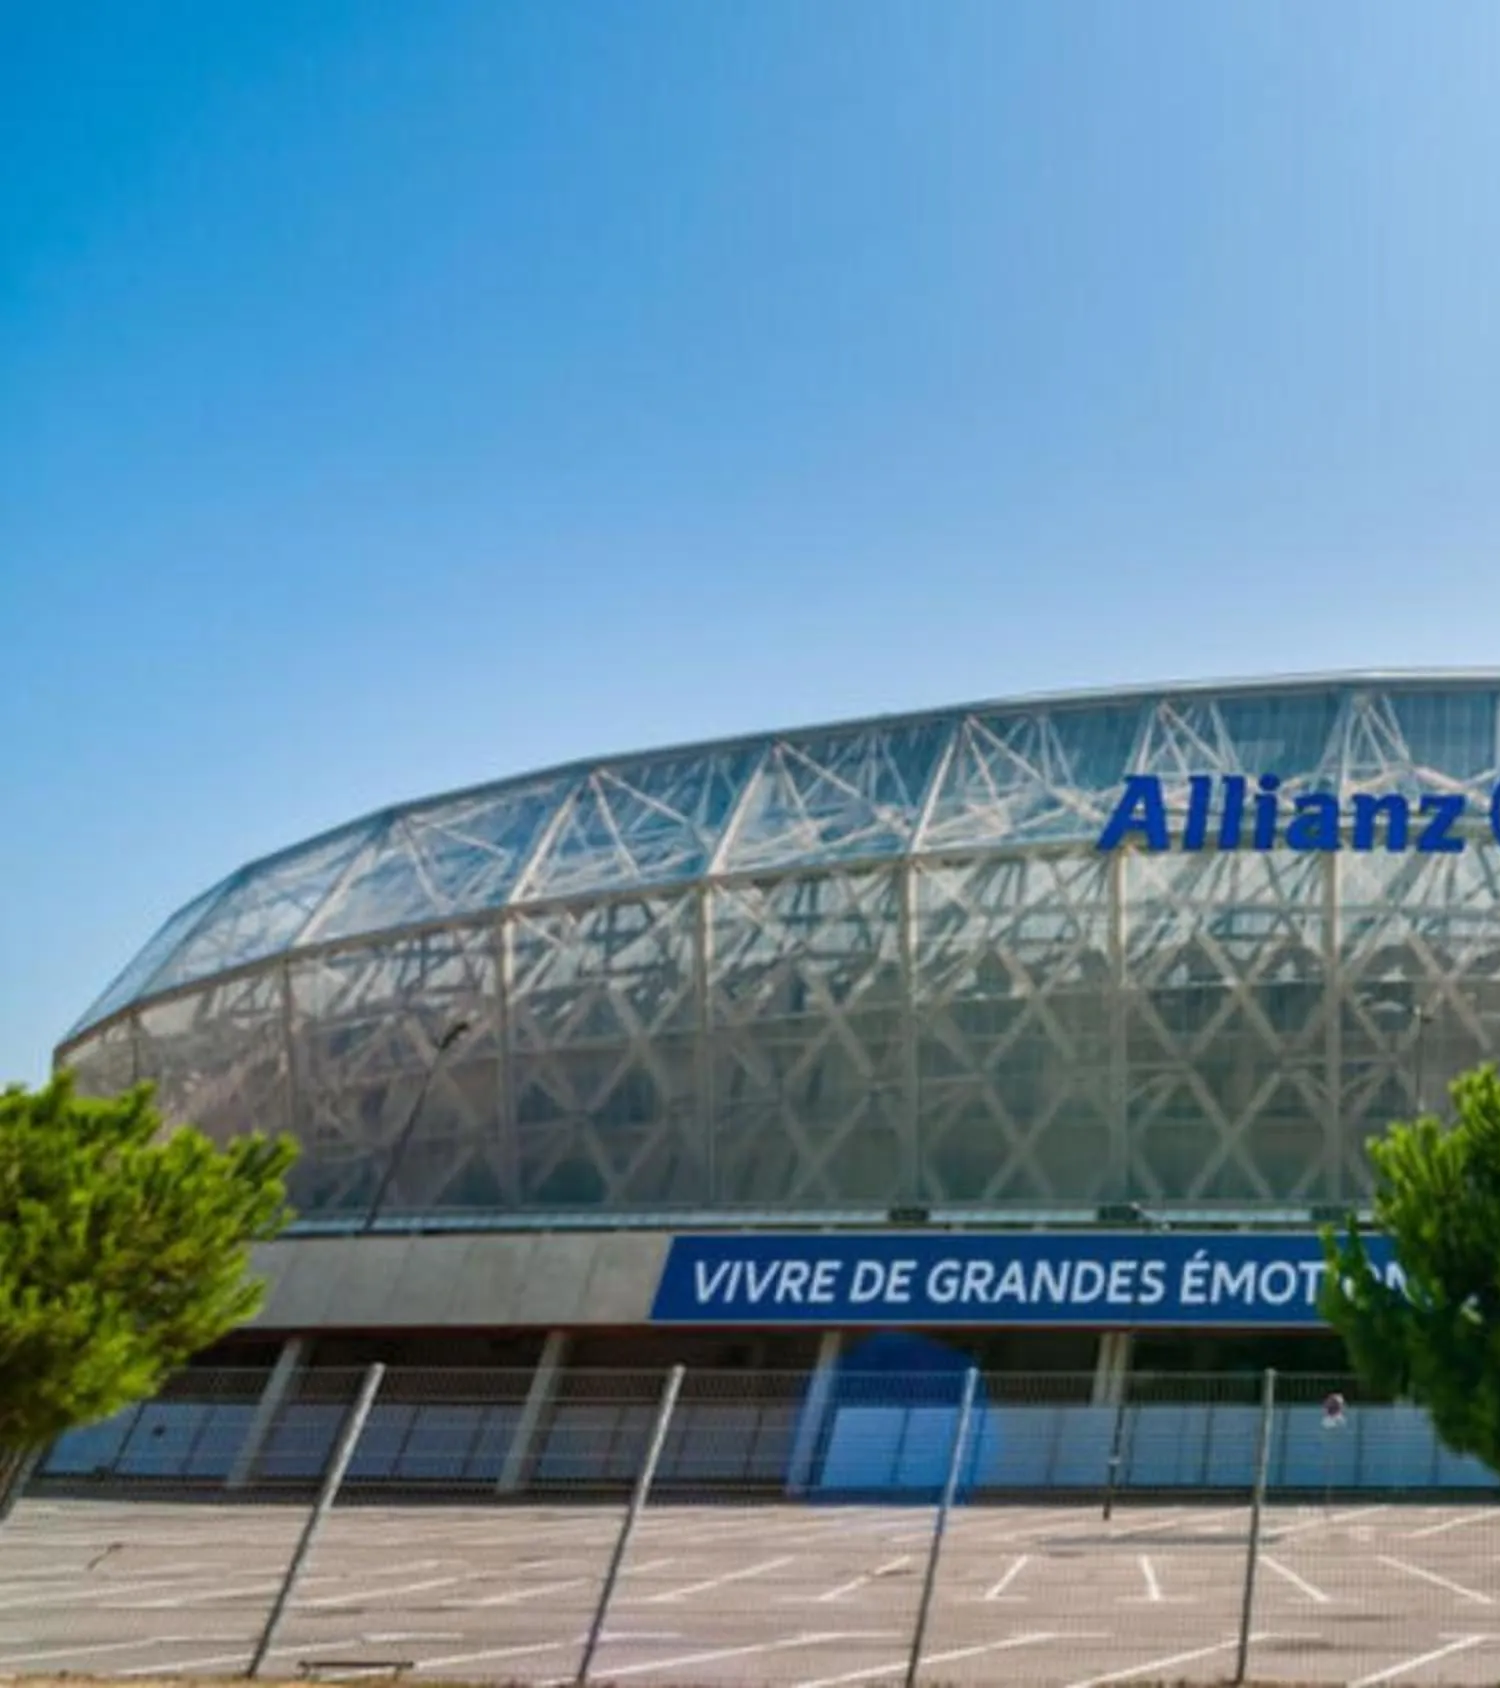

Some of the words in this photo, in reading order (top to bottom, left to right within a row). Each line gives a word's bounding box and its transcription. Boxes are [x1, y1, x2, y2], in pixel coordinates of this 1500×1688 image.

[1097, 772, 1467, 853] Allianz
[694, 1259, 842, 1303] VIVRE
[848, 1259, 918, 1303] DE
[926, 1258, 1166, 1304] GRANDES
